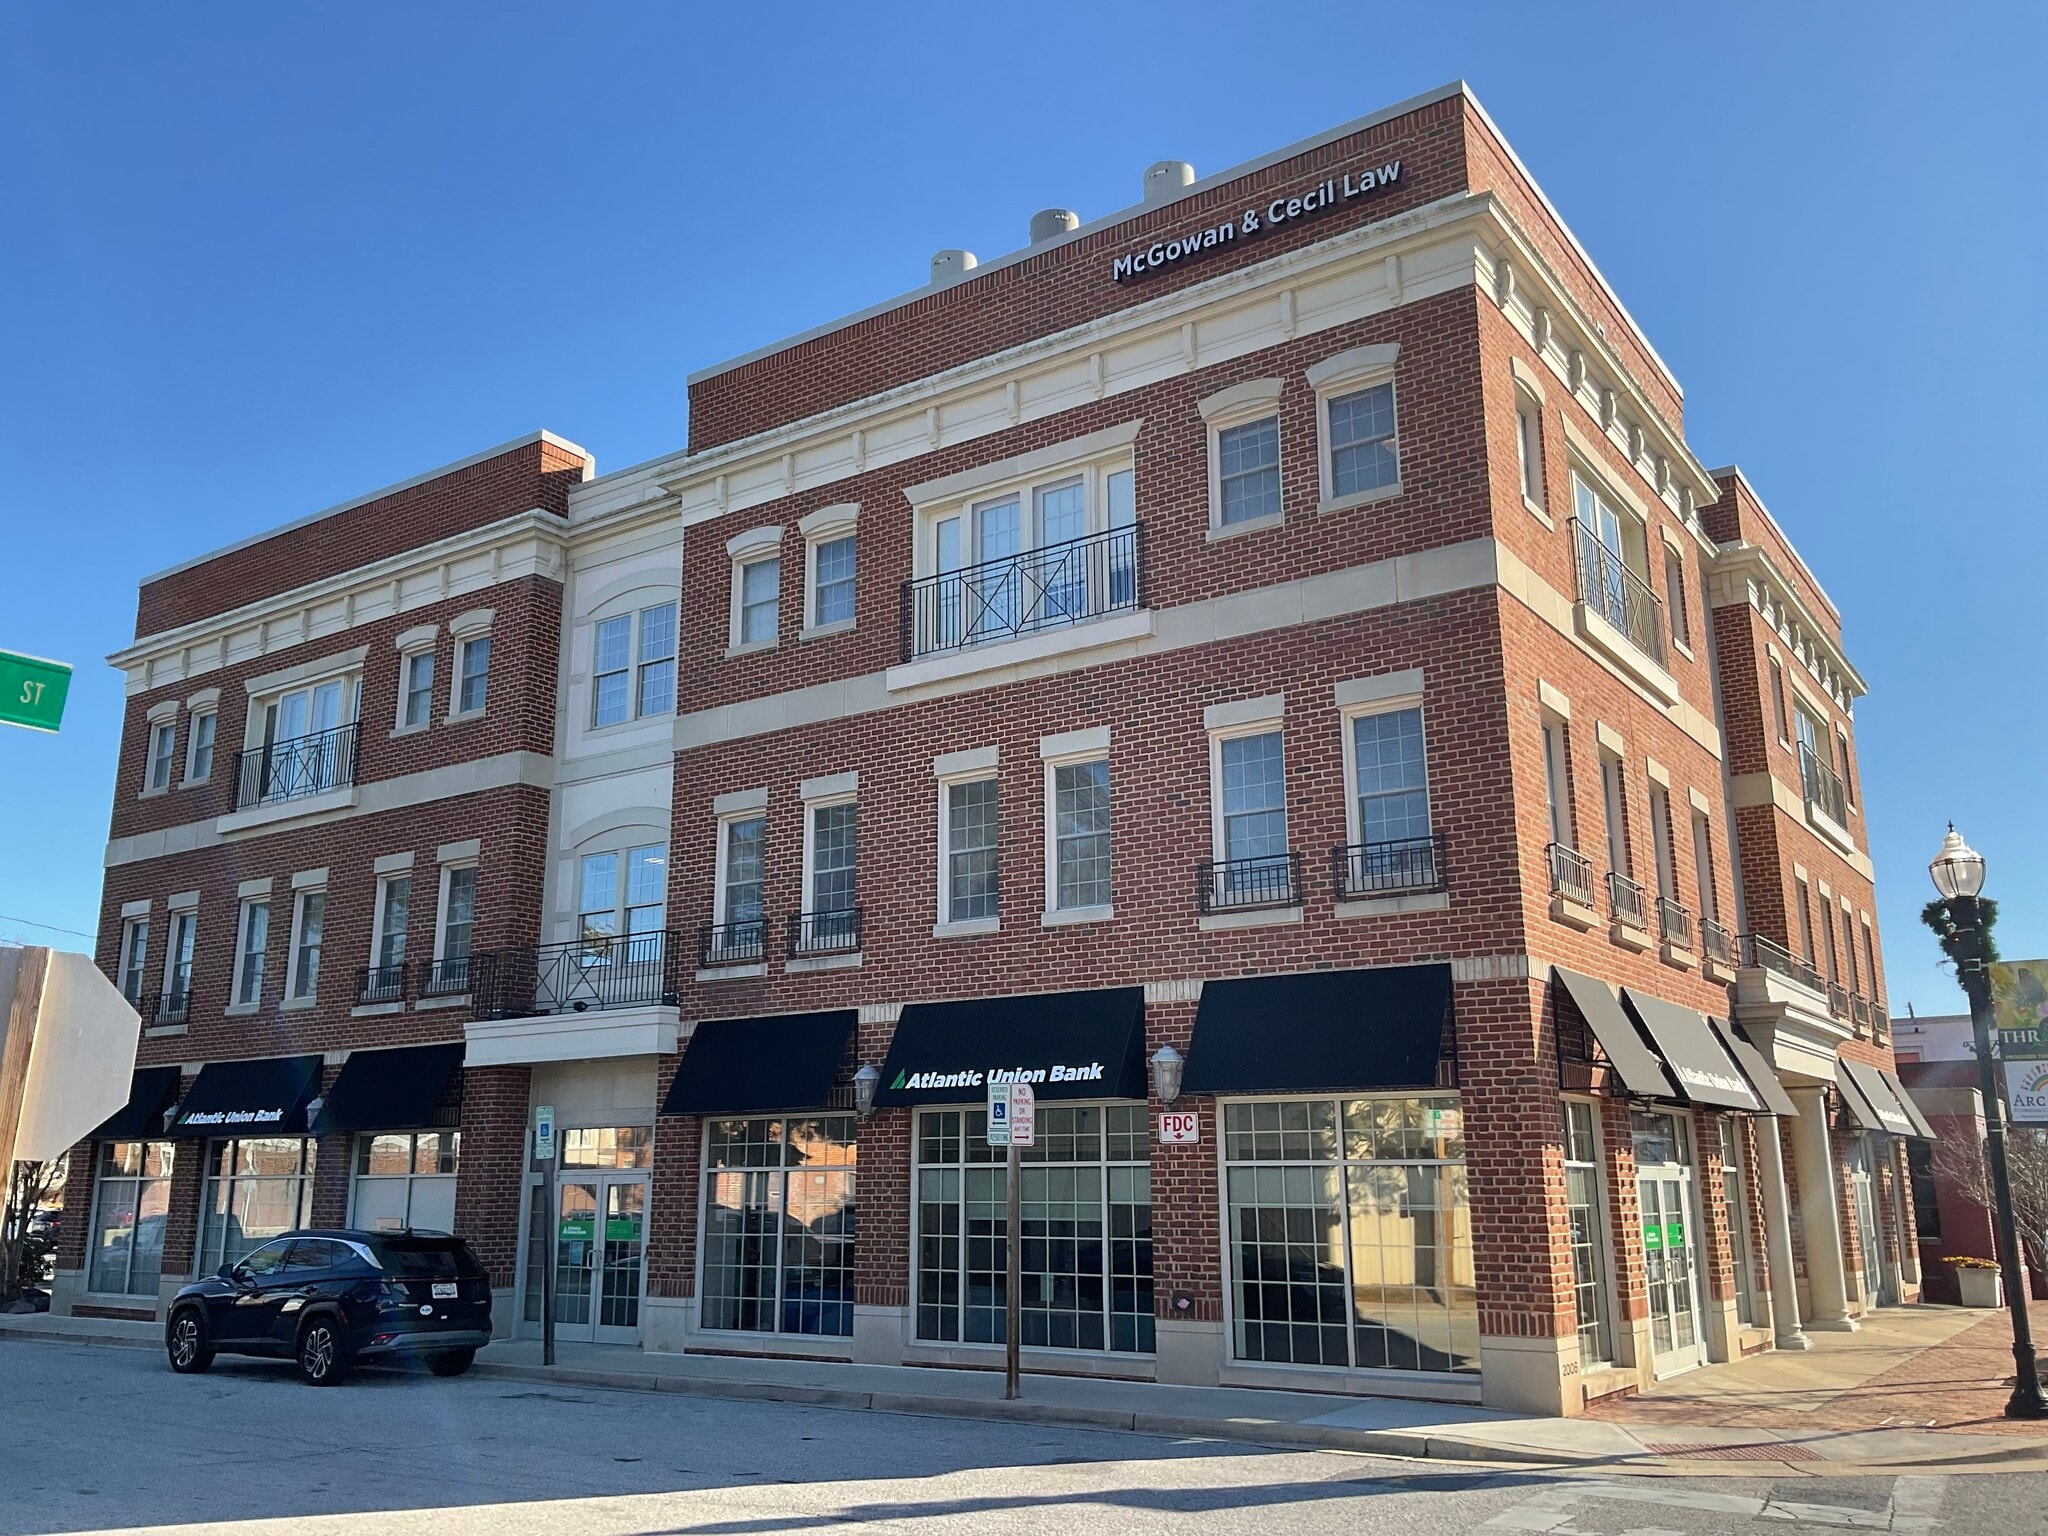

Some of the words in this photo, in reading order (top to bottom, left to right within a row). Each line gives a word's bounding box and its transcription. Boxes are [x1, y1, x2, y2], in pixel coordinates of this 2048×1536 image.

[1113, 222, 1234, 281] McGowan
[1241, 209, 1260, 233] &
[1268, 180, 1334, 223] Cecil
[1343, 160, 1401, 198] Law
[20, 680, 46, 705] ST
[905, 1069, 983, 1089] Atlantic
[986, 1067, 1046, 1084] Union
[1049, 1062, 1105, 1082] Bank
[1018, 1087, 1027, 1096] NO
[185, 1112, 225, 1124] Atlantic
[225, 1110, 255, 1123] Union
[254, 1108, 284, 1122] Bank
[1018, 1107, 1026, 1115] OR
[1163, 1115, 1194, 1132] FDC
